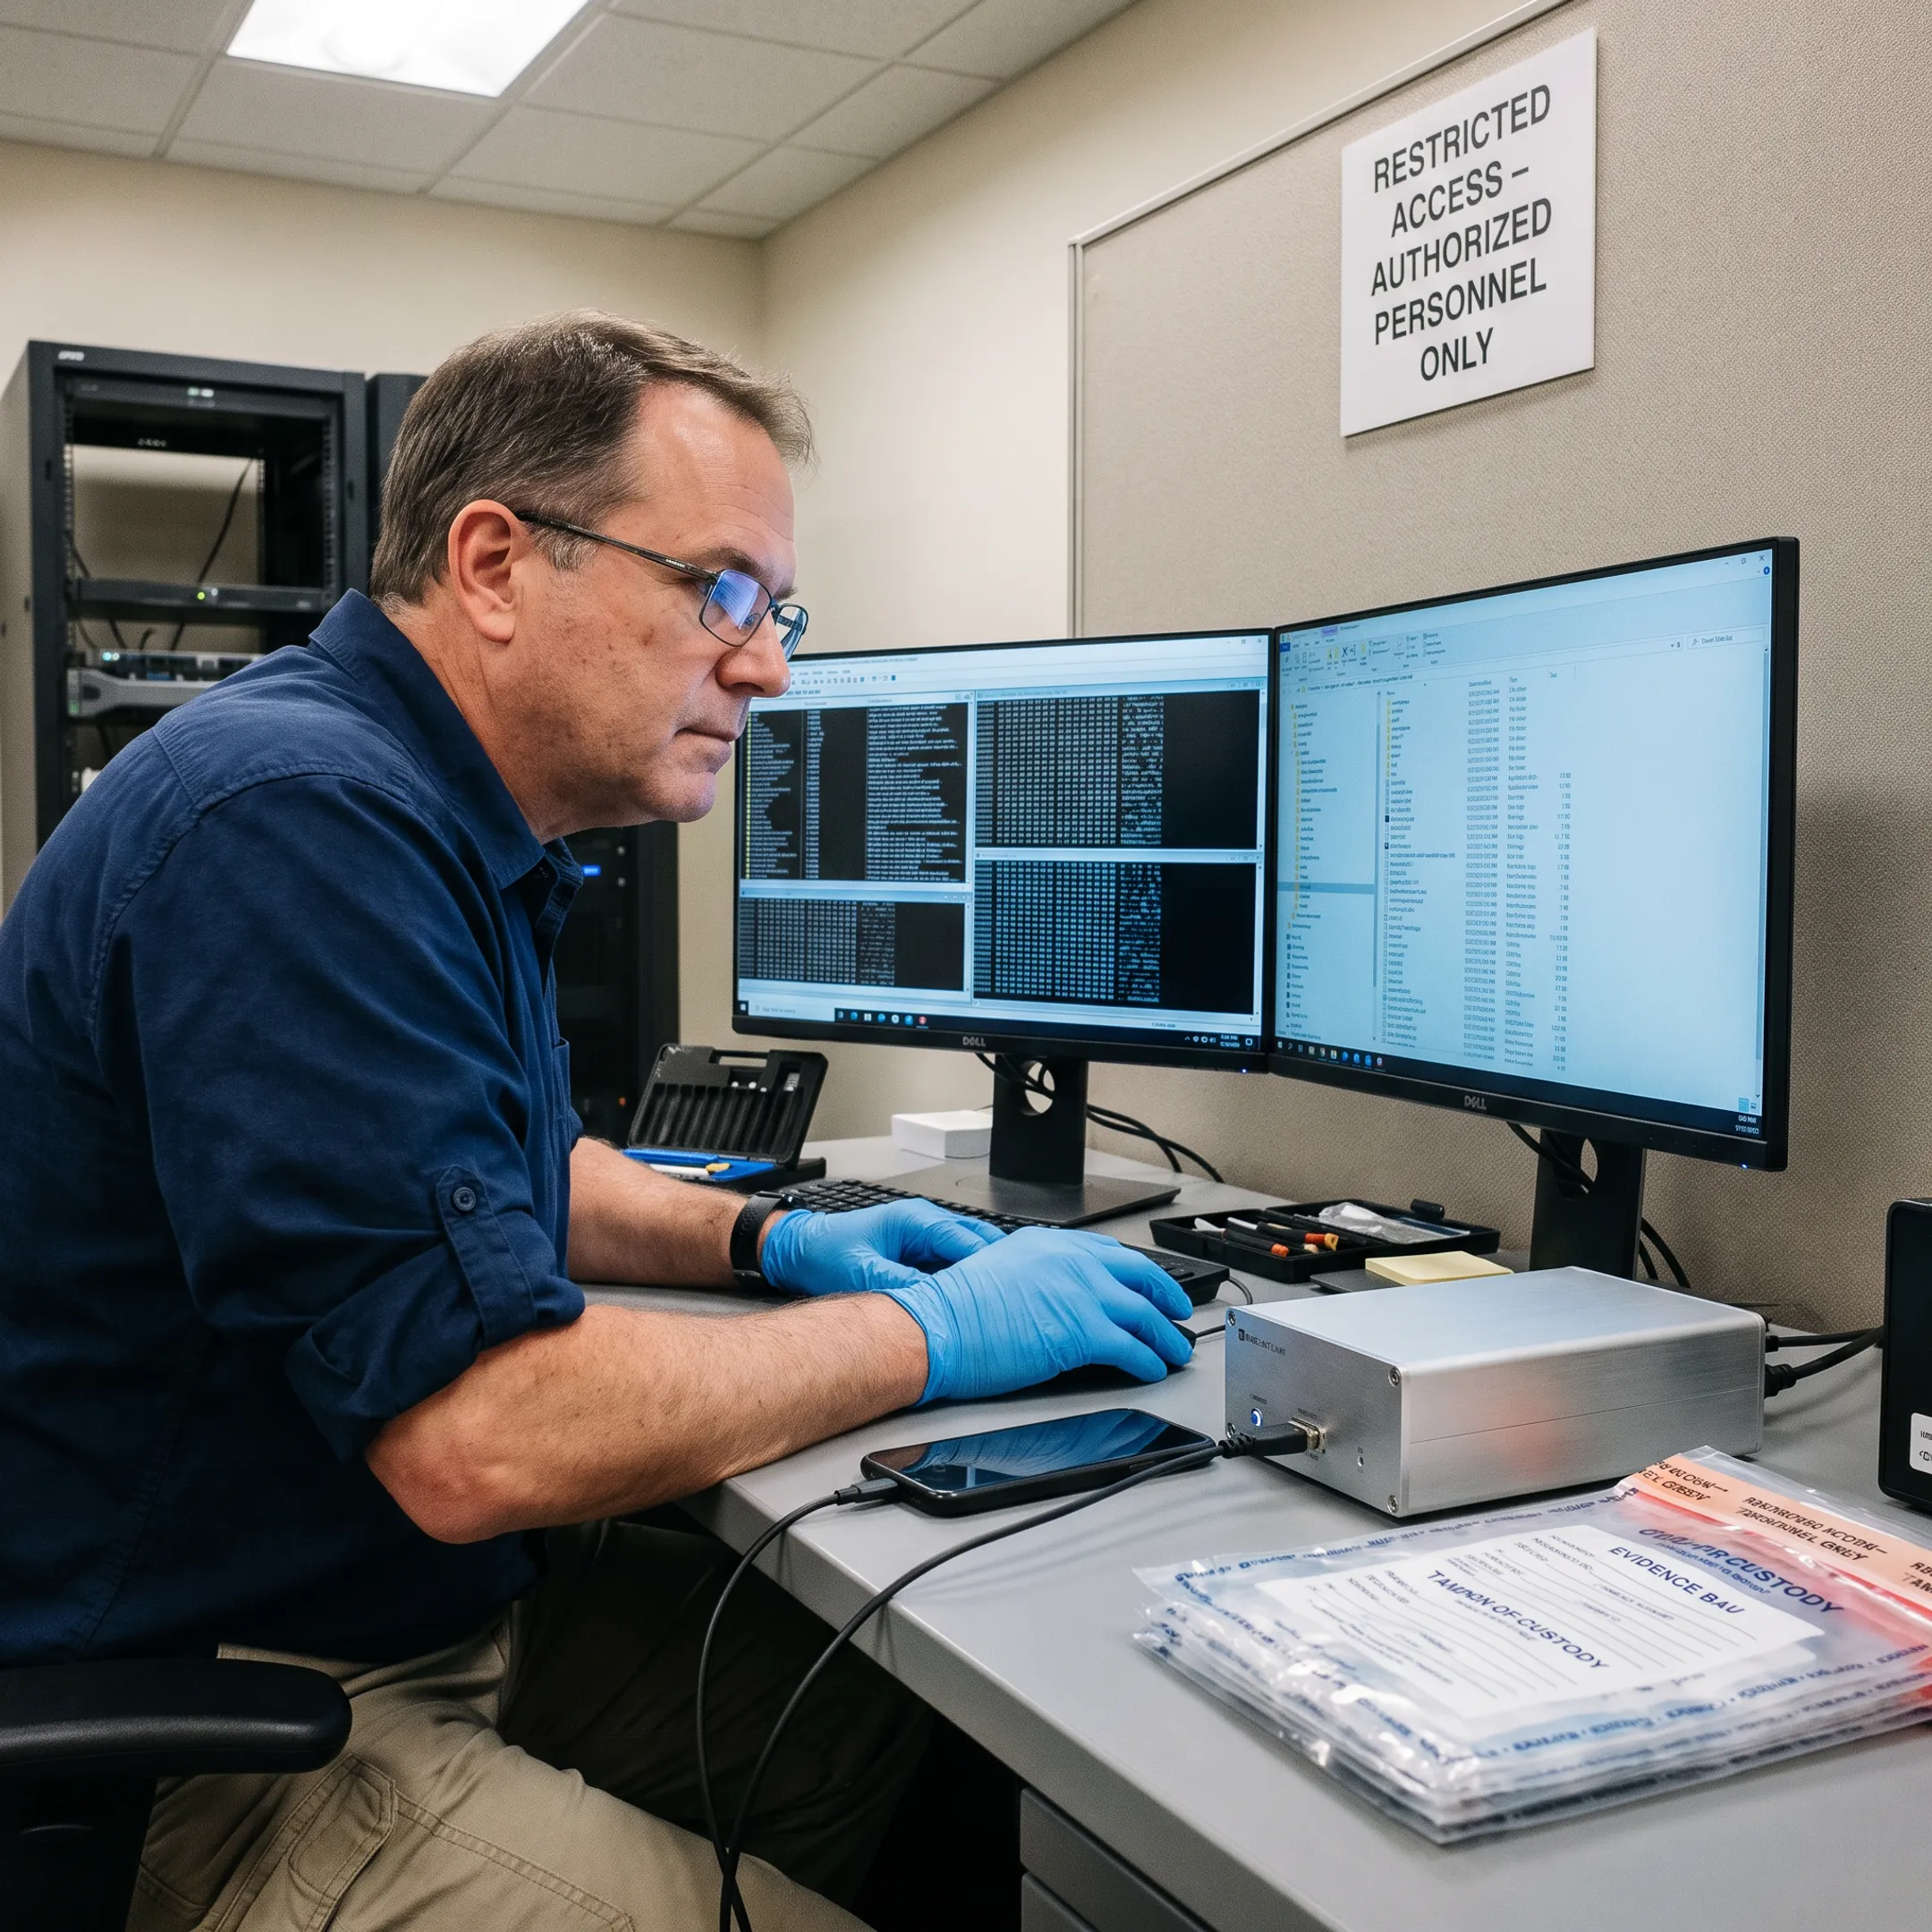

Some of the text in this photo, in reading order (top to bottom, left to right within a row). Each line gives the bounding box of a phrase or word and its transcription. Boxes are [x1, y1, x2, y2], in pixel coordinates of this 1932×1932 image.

[1374, 84, 1551, 194] RESTRICTED
[1391, 161, 1503, 238] ACCESS
[1371, 198, 1552, 296] AUTHORIZED
[1375, 258, 1546, 345] PERSONNEL
[1420, 326, 1494, 382] ONLY
[1608, 1546, 1703, 1595] EVIDENCE
[1725, 1557, 1844, 1613] CUSTODY
[1492, 1606, 1523, 1619] OF
[1517, 1617, 1610, 1669] CUSTODY
